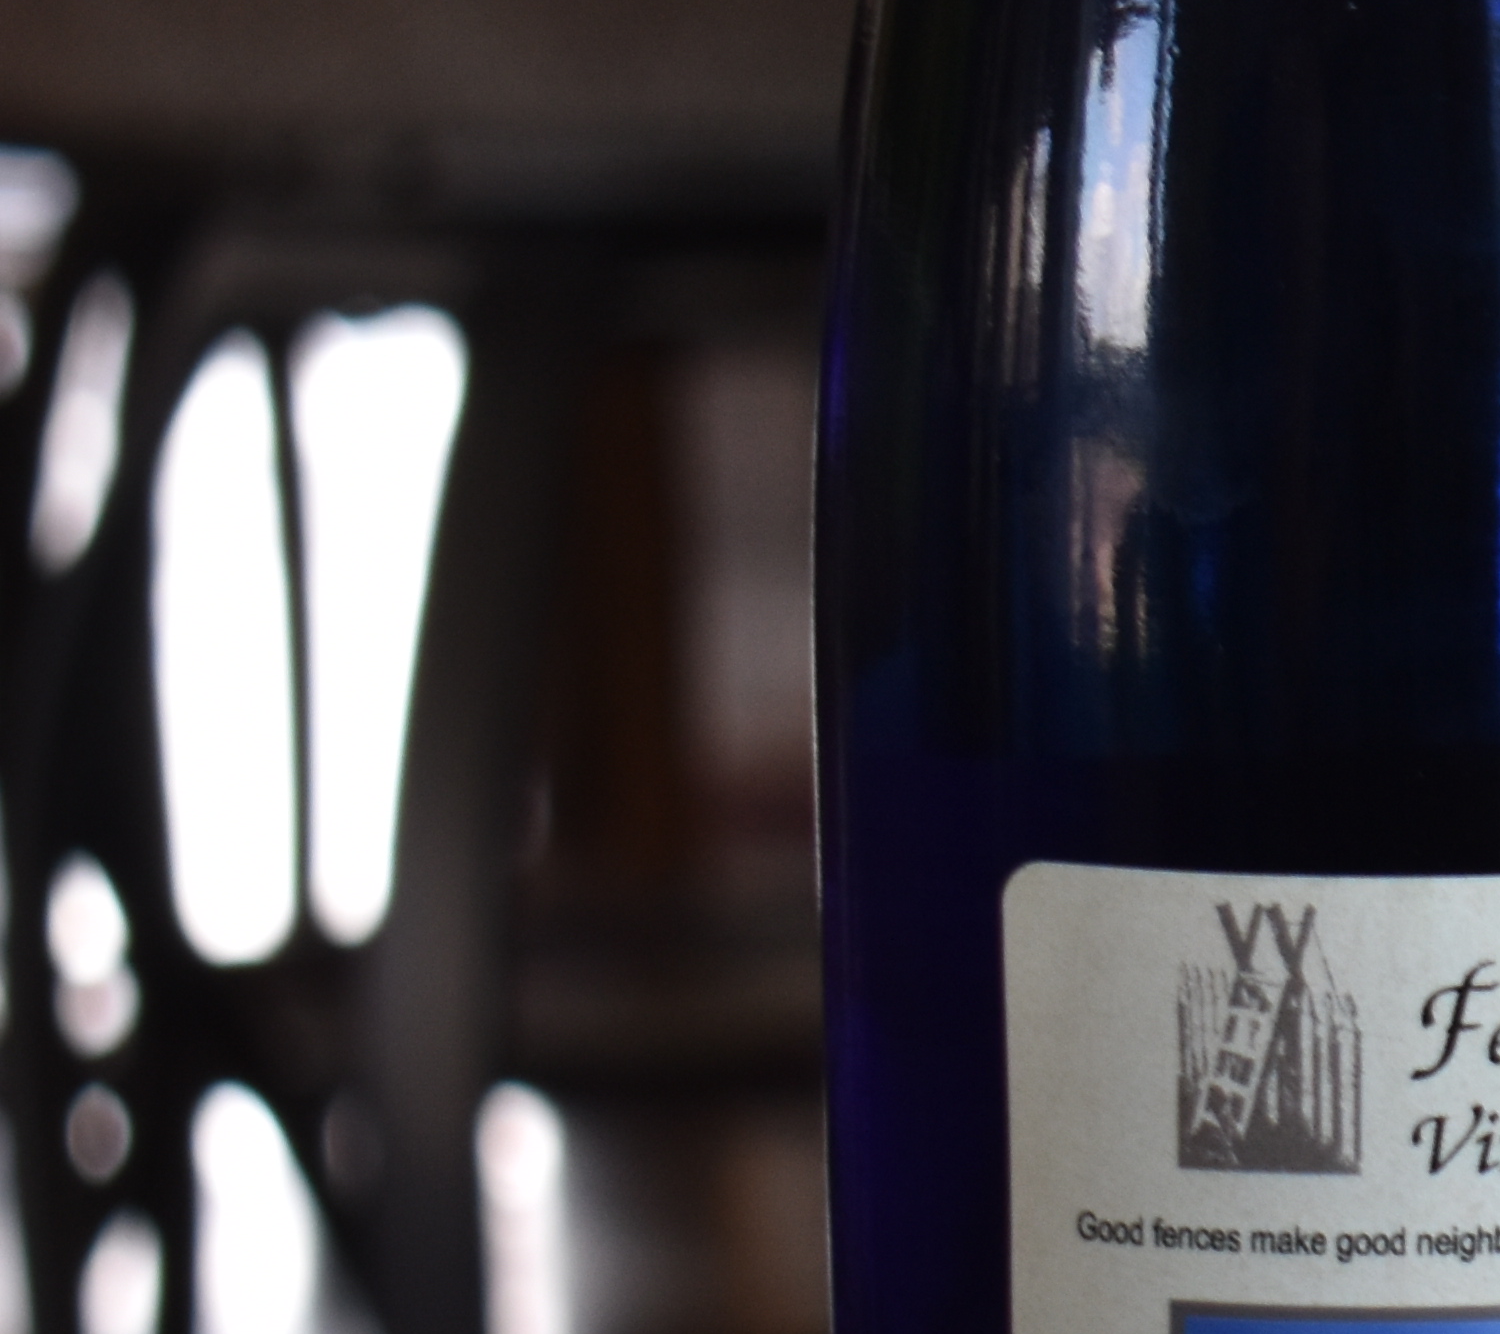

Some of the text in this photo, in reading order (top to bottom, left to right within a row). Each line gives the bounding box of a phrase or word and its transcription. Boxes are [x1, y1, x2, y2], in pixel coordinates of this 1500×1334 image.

[1076, 1210, 1145, 1247] Good
[1152, 1217, 1242, 1253] fences
[1250, 1225, 1328, 1256] make
[1336, 1227, 1406, 1263] good
